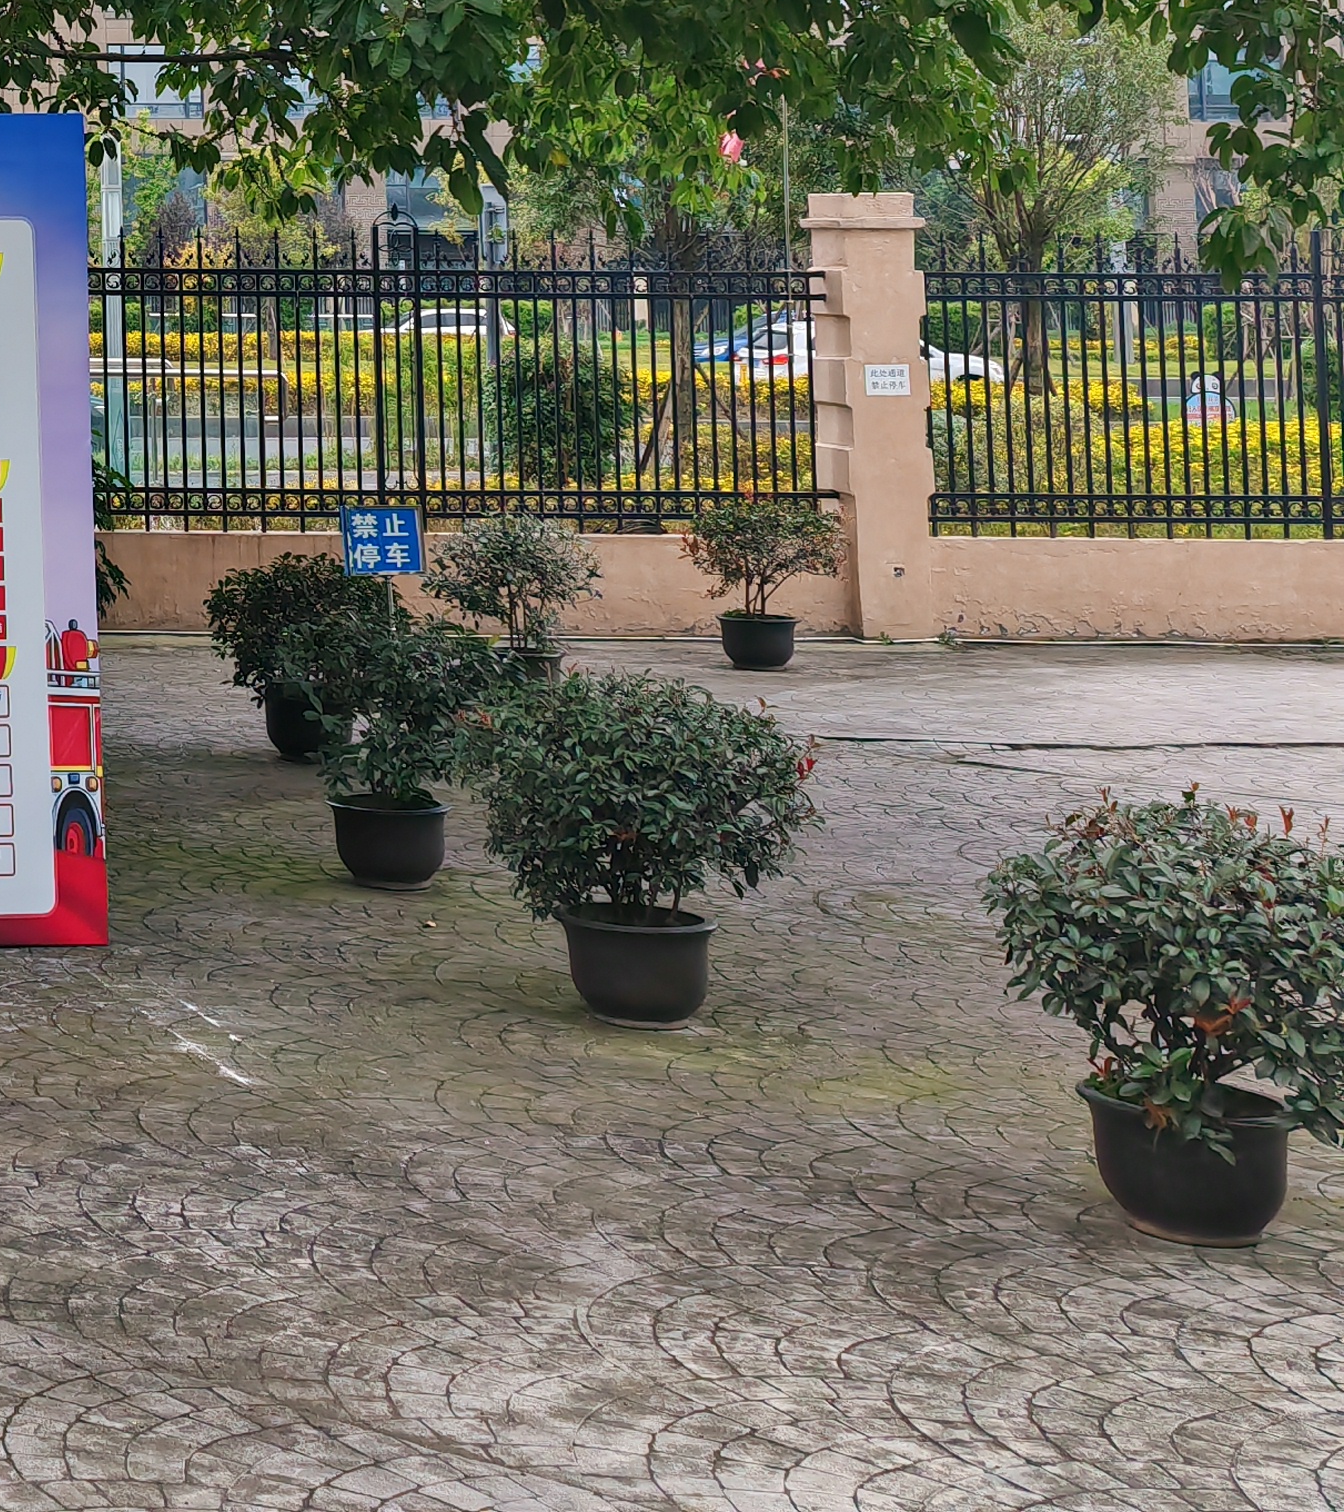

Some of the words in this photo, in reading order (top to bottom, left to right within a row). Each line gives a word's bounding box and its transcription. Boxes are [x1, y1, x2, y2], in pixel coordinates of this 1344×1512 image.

[870, 368, 905, 378] 此处通道
[871, 381, 905, 389] 禁止停车
[351, 513, 409, 538] 禁止
[354, 543, 410, 569] 停车
